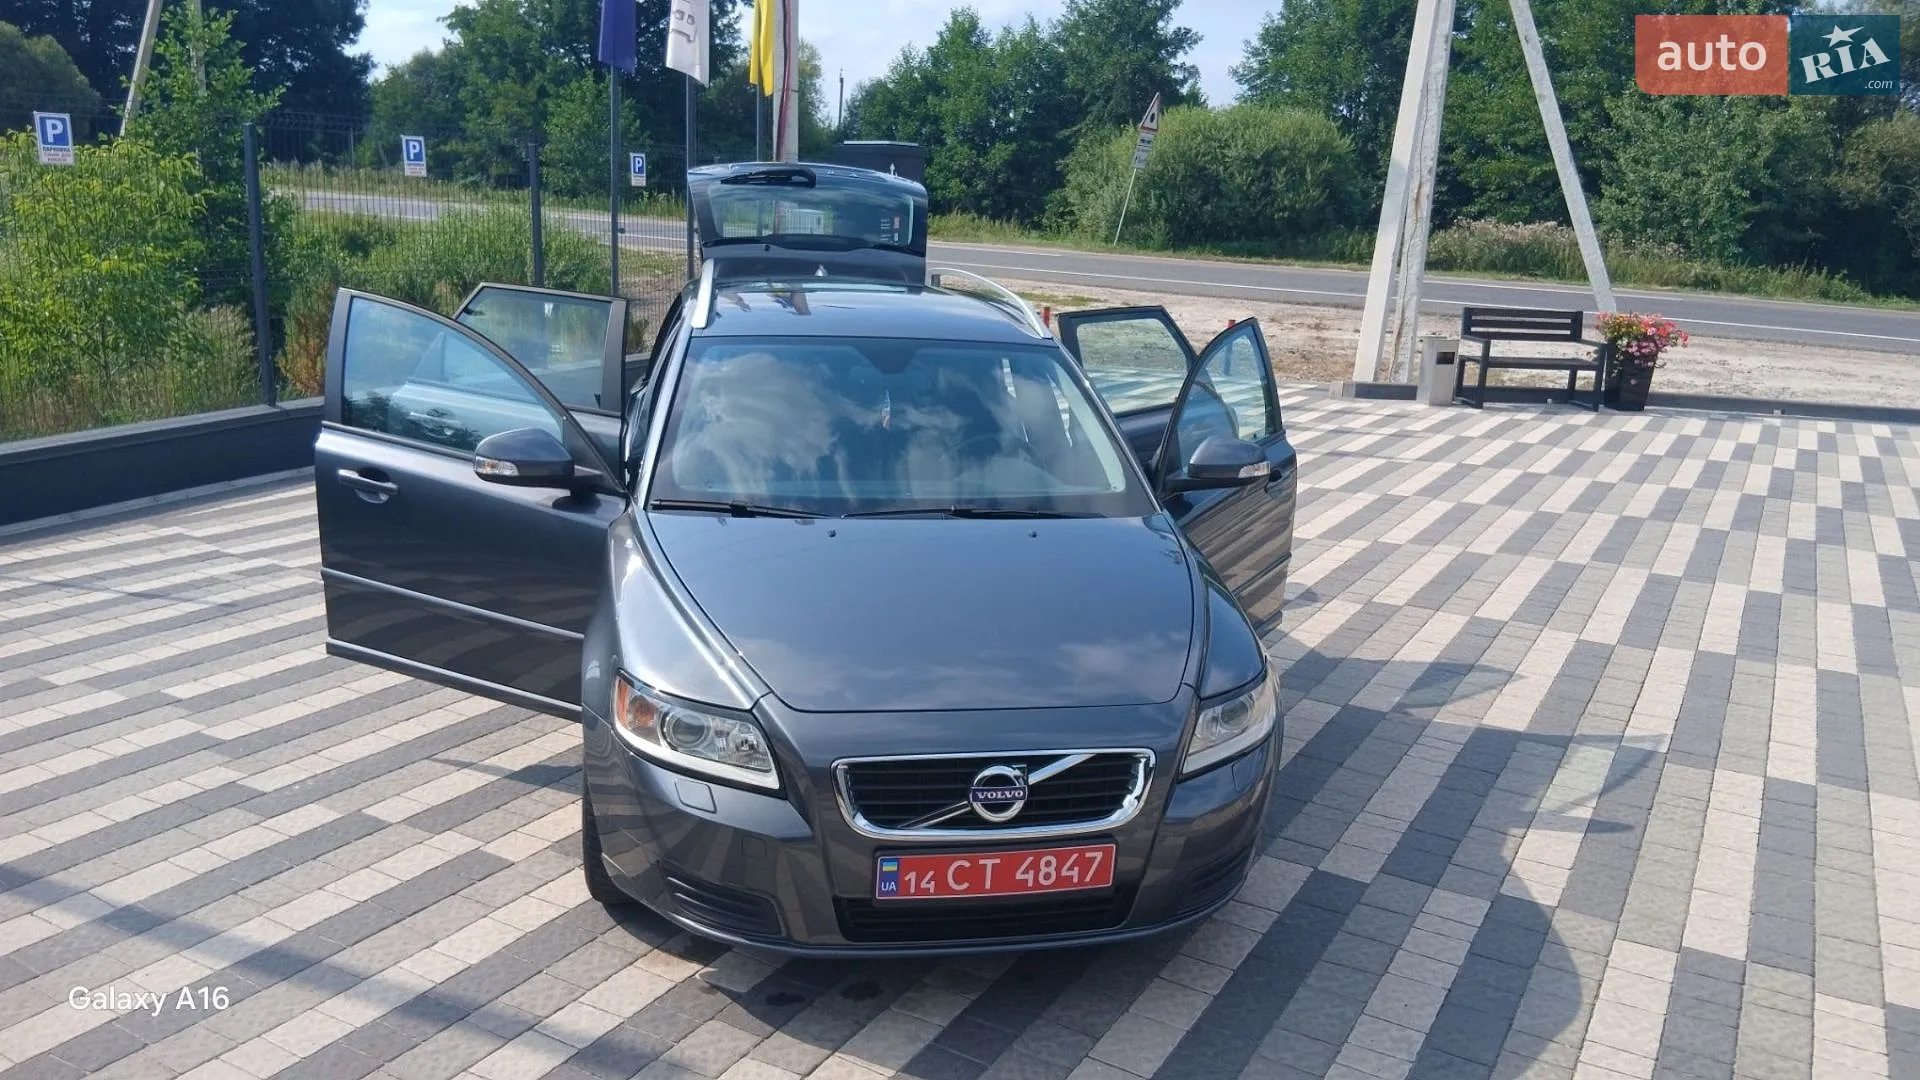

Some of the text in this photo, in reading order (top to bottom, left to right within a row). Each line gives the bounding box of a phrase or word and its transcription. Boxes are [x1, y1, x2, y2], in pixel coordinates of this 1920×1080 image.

[46, 119, 63, 143] P
[409, 141, 420, 160] P
[635, 157, 643, 173] P
[976, 790, 1024, 799] VOLVO
[904, 851, 1103, 893] 14 CT 4847
[881, 881, 897, 892] UA
